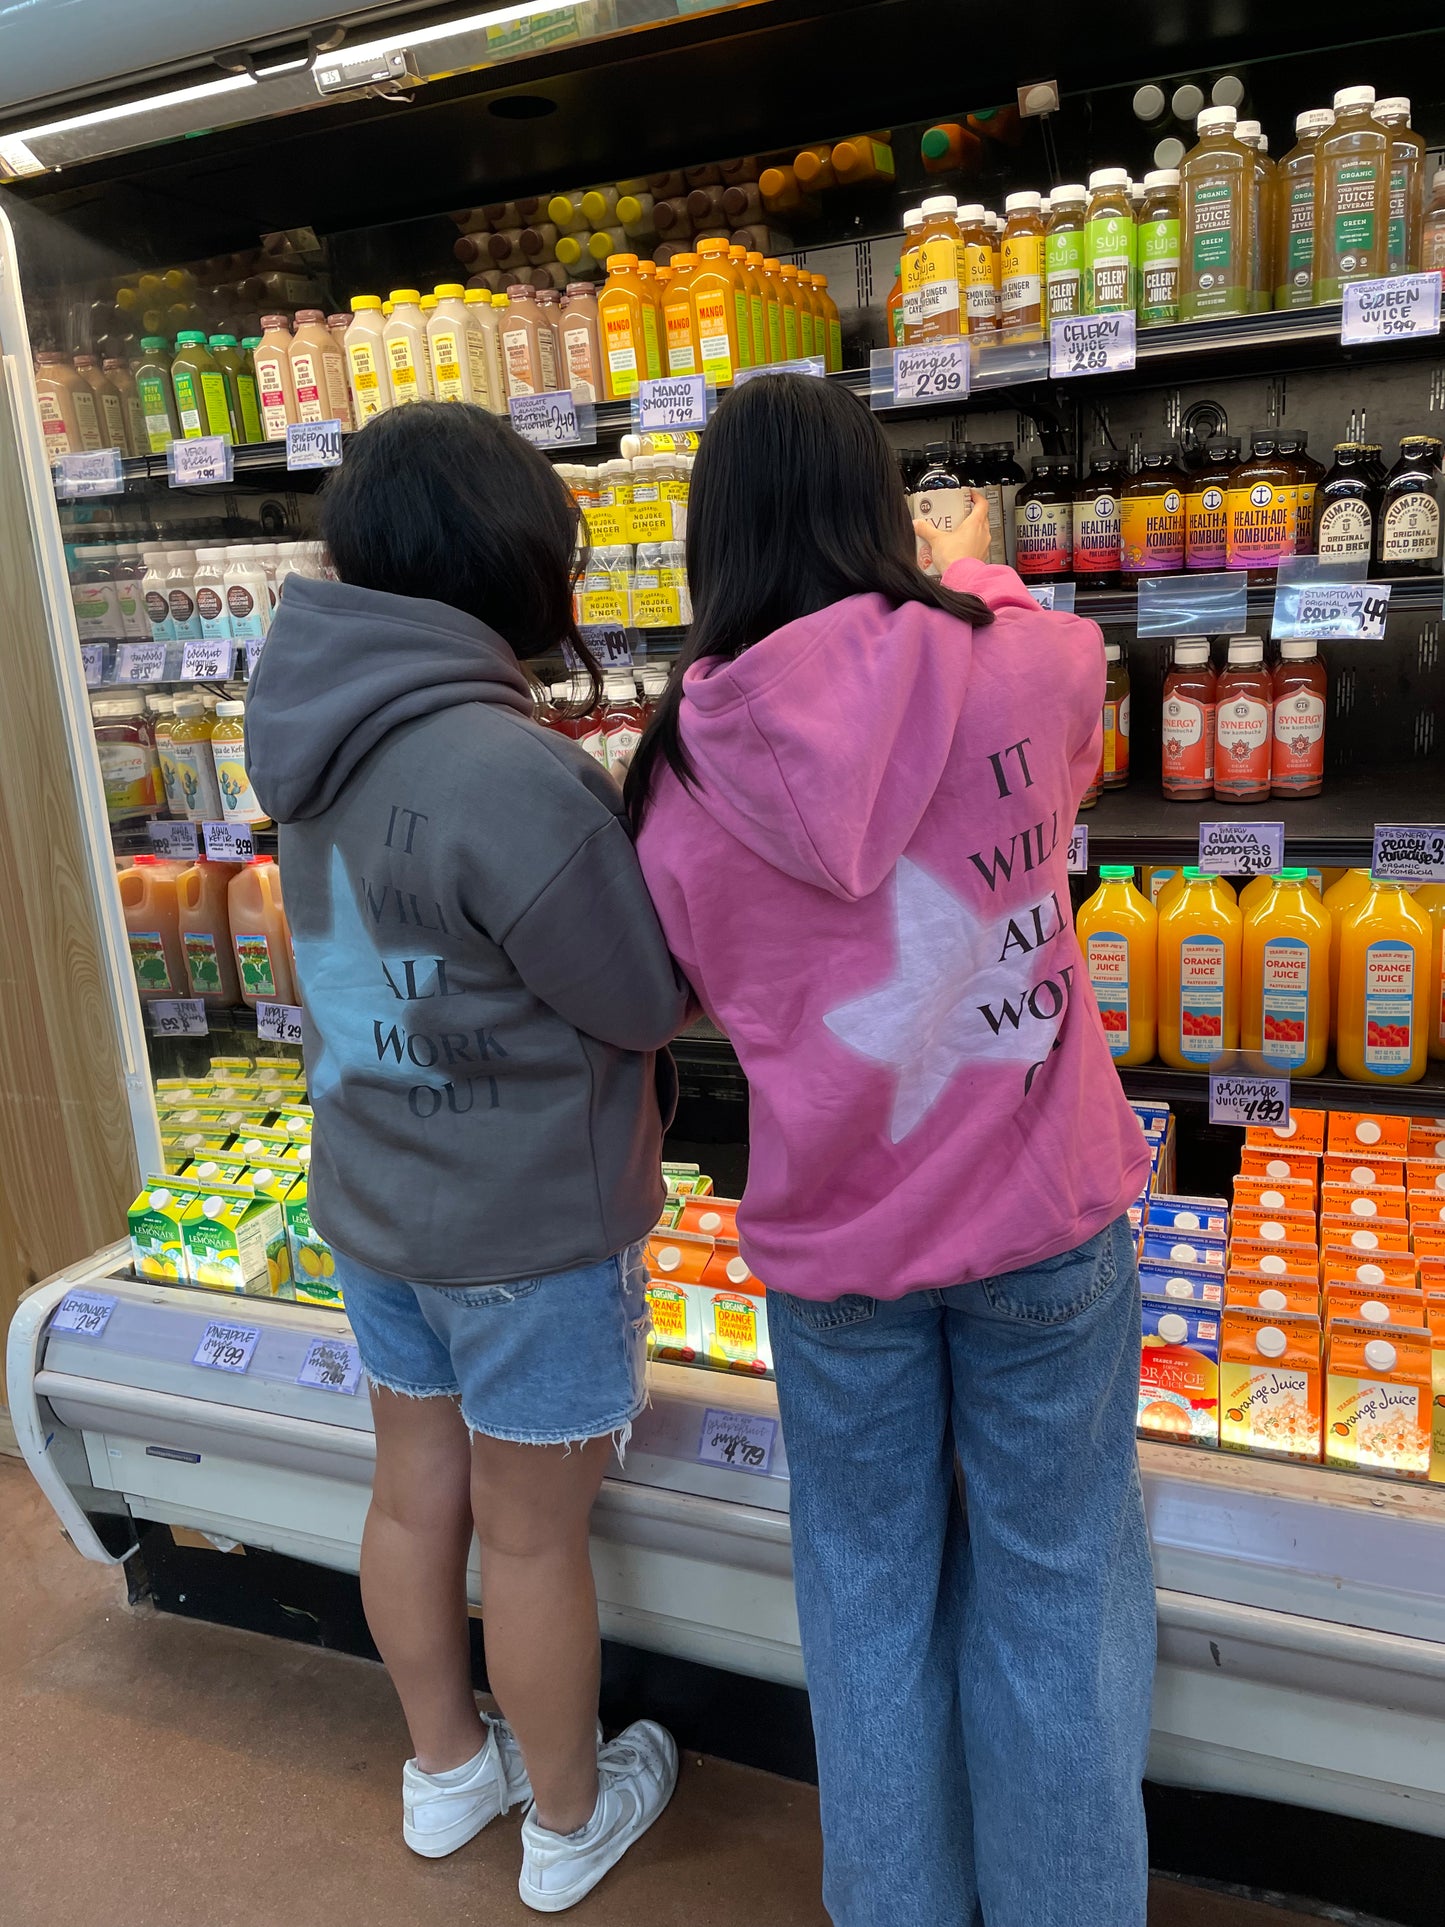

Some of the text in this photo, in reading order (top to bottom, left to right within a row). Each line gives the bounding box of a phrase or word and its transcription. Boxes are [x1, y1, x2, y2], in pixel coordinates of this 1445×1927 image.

[1341, 171, 1372, 179] ORGANIC
[1198, 190, 1228, 200] ORGANIC
[1338, 191, 1375, 204] JUICE
[1338, 201, 1374, 211] BEVERAGE
[1195, 210, 1230, 223] JUICE
[1343, 219, 1367, 227] GREEN
[1195, 220, 1230, 230] BEVERAGE
[1096, 234, 1128, 252] suja
[1146, 236, 1177, 252] suja
[1201, 237, 1224, 246] GREEN
[1048, 249, 1078, 265] suja
[1097, 270, 1126, 286] CELERY
[1146, 271, 1176, 288] CELERY
[926, 286, 947, 297] GINGER
[1008, 281, 1030, 292] GINGER
[1049, 282, 1077, 300] CELERY
[1099, 285, 1123, 301] JUICE
[1149, 286, 1172, 303] JUICE
[1359, 288, 1420, 310] GREEN
[1051, 297, 1073, 313] JUICE
[699, 305, 724, 319] MANGO
[1362, 306, 1412, 323] JUICE
[607, 319, 630, 332] MANGO
[668, 318, 690, 331] MANGO
[1064, 320, 1120, 343] CELERY
[1069, 338, 1110, 354] JUICE
[900, 353, 962, 378] ginger
[652, 383, 691, 398] MANGO
[916, 372, 961, 398] 2.99
[642, 397, 694, 411] SMOOTHIE
[513, 410, 549, 422] PROTEIN
[291, 432, 316, 446] SPICED
[291, 443, 310, 454] CHAI
[1322, 502, 1371, 530] STUMPTOWN
[1388, 496, 1438, 526] STUMPTOWN
[632, 520, 666, 530] GINGER
[1234, 526, 1287, 544] KOMBUCHA
[1327, 535, 1365, 543] ORIGINAL
[1393, 530, 1432, 538] ORIGINAL
[1321, 541, 1370, 553] COLD BREW
[1386, 537, 1436, 548] COLD BREW
[1304, 591, 1363, 599] STUMPTOWN
[589, 609, 622, 618] GINGER
[639, 606, 673, 615] GINGER
[1303, 606, 1341, 620] COLD
[1220, 719, 1265, 729] SYNERGY
[1278, 715, 1322, 725] SYNERGY
[986, 737, 1034, 799] IT
[384, 805, 428, 855] IT
[1395, 832, 1433, 840] SYNERGY
[1208, 833, 1258, 845] GUAVA
[1203, 845, 1271, 857] GODDESS
[361, 877, 464, 941] WILL
[1090, 953, 1126, 961] ORANGE
[1183, 957, 1222, 965] ORANGE
[1096, 963, 1120, 971] JUICE
[1189, 967, 1215, 975] JUICE
[1266, 960, 1307, 969] ORANGE
[1369, 964, 1411, 973] ORANGE
[381, 959, 466, 1001] ALL
[1272, 971, 1299, 979] JUICE
[1375, 974, 1403, 983] JUICE
[264, 1006, 289, 1018] APPLE
[371, 1019, 510, 1068] WORK
[407, 1074, 506, 1119] OUT
[1217, 1083, 1279, 1101] orange
[1216, 1096, 1248, 1106] JUICE
[134, 1226, 175, 1239] LEMONADE
[189, 1235, 232, 1248] LEMONADE
[1350, 1290, 1375, 1298] TRADER
[63, 1299, 110, 1318] LEMONADE
[650, 1300, 682, 1313] ORANGE
[722, 1301, 747, 1313] ORGANIC
[718, 1310, 752, 1325] ORANGE
[1246, 1316, 1272, 1324] TRADER
[207, 1325, 256, 1343] PINEAPPLE
[719, 1327, 753, 1342] BANANA
[1353, 1328, 1381, 1337] TRADER
[1139, 1366, 1205, 1385] ORANGE
[1156, 1379, 1183, 1390] JUICE
[1227, 1374, 1305, 1422] Orange Juice
[1332, 1388, 1416, 1436] Orange Juice
